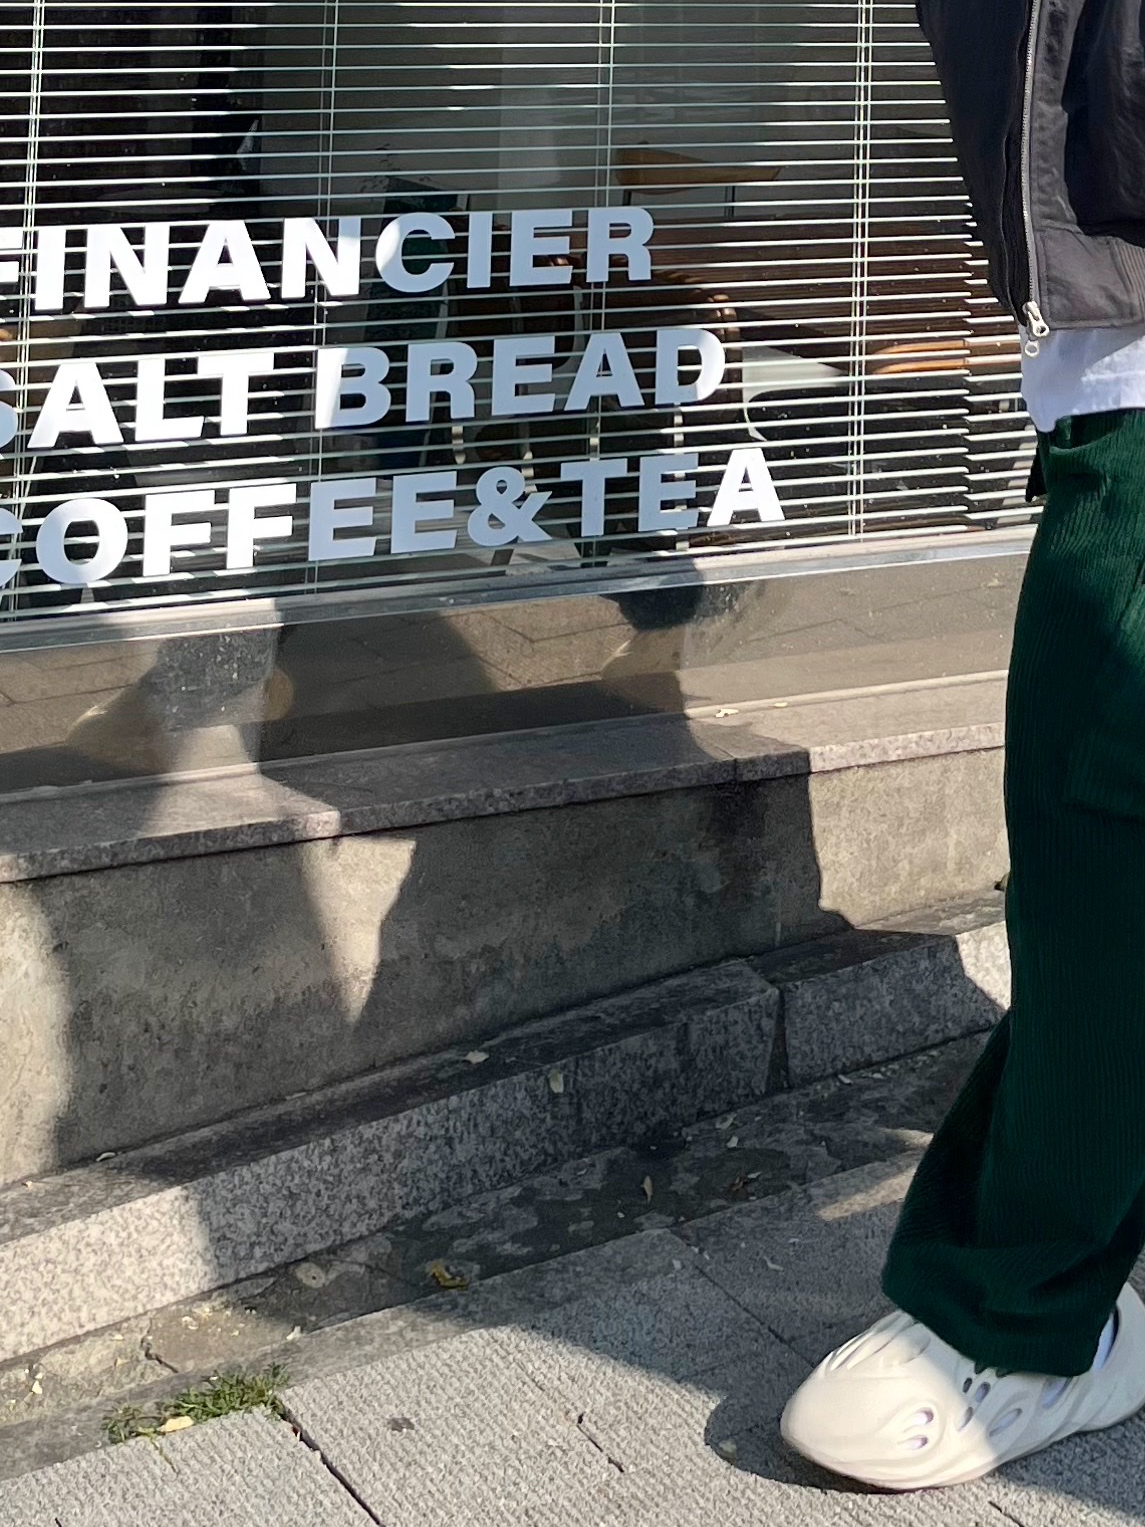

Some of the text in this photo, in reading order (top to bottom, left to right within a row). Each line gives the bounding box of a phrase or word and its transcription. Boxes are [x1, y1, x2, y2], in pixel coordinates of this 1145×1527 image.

[0, 328, 726, 449] ALT BREAD
[0, 447, 786, 589] OFFEE&TEA
